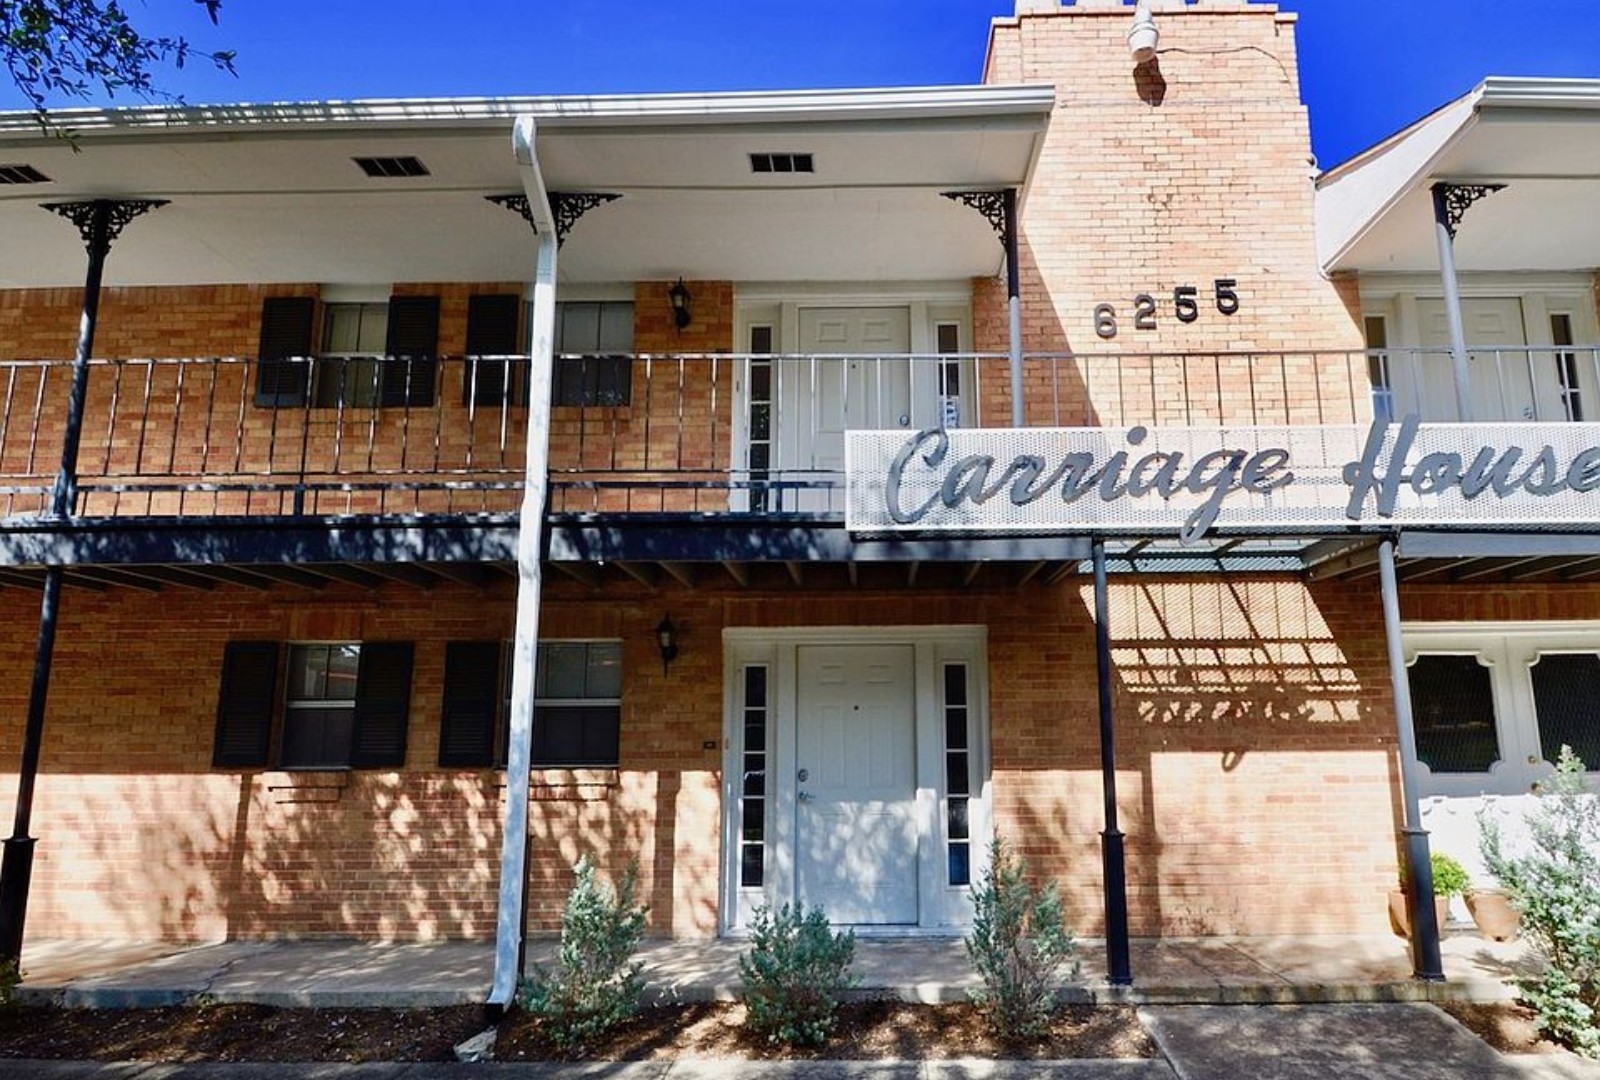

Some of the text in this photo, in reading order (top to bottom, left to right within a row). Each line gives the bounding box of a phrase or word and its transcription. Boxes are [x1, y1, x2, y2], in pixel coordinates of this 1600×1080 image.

[1094, 279, 1239, 339] 6255
[885, 413, 1600, 546] Carriage House
